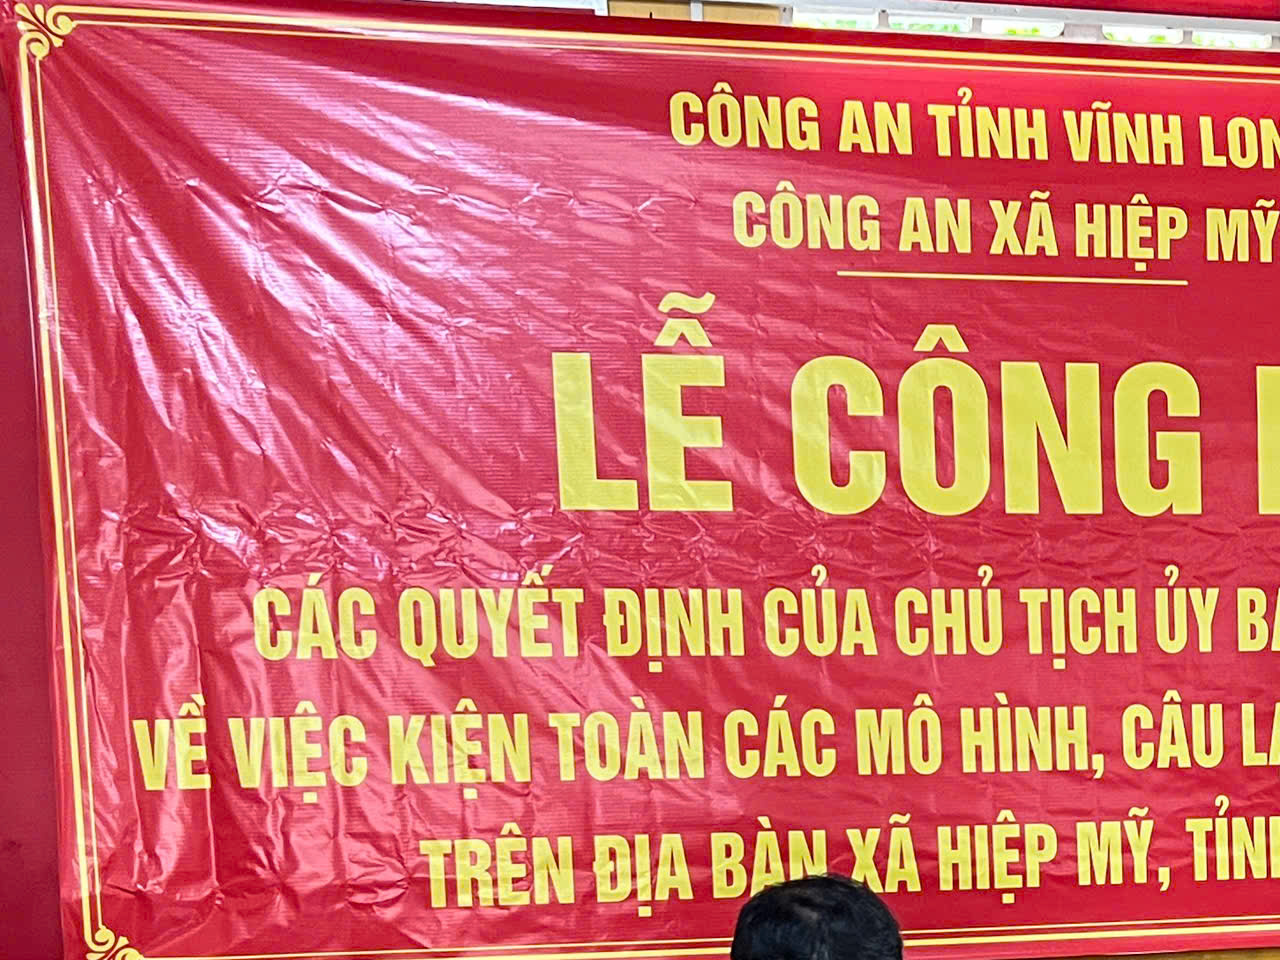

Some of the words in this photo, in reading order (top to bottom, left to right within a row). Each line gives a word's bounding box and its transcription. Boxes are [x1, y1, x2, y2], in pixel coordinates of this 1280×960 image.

[668, 82, 821, 151] CÔNG
[838, 100, 913, 155] AN
[926, 87, 1049, 161] TỈNH
[1062, 101, 1184, 166] VĨNH
[734, 181, 881, 251] CÔNG
[898, 197, 972, 254] AN
[989, 190, 1059, 257] XÃ
[1075, 192, 1188, 272] HIỆP
[1206, 199, 1280, 262] MỸ
[551, 292, 734, 513] LỄ
[790, 324, 1203, 517] CÔNG
[253, 574, 377, 660] CÁC
[399, 565, 585, 667] QUYẾT
[601, 588, 745, 673] ĐỊNH
[763, 565, 878, 657] CỦA
[893, 565, 1004, 657] CHỦ
[1018, 587, 1137, 670] TỊCH
[1154, 565, 1219, 654] ỦY
[132, 693, 212, 791] VỀ
[229, 703, 369, 802] VIỆC
[389, 698, 532, 800] KIỆN
[548, 696, 705, 781] TOÀN
[723, 695, 838, 779] CÁC
[855, 693, 943, 776] MÔ
[959, 691, 1105, 779] HÌNH,
[1122, 690, 1224, 771] CÂU
[418, 823, 575, 909] TRÊN
[592, 833, 694, 917] ĐỊA
[711, 816, 828, 899] BÀN
[846, 813, 921, 894] XÃ
[936, 810, 1058, 904] HIỆP
[1076, 807, 1171, 892] MỸ,
